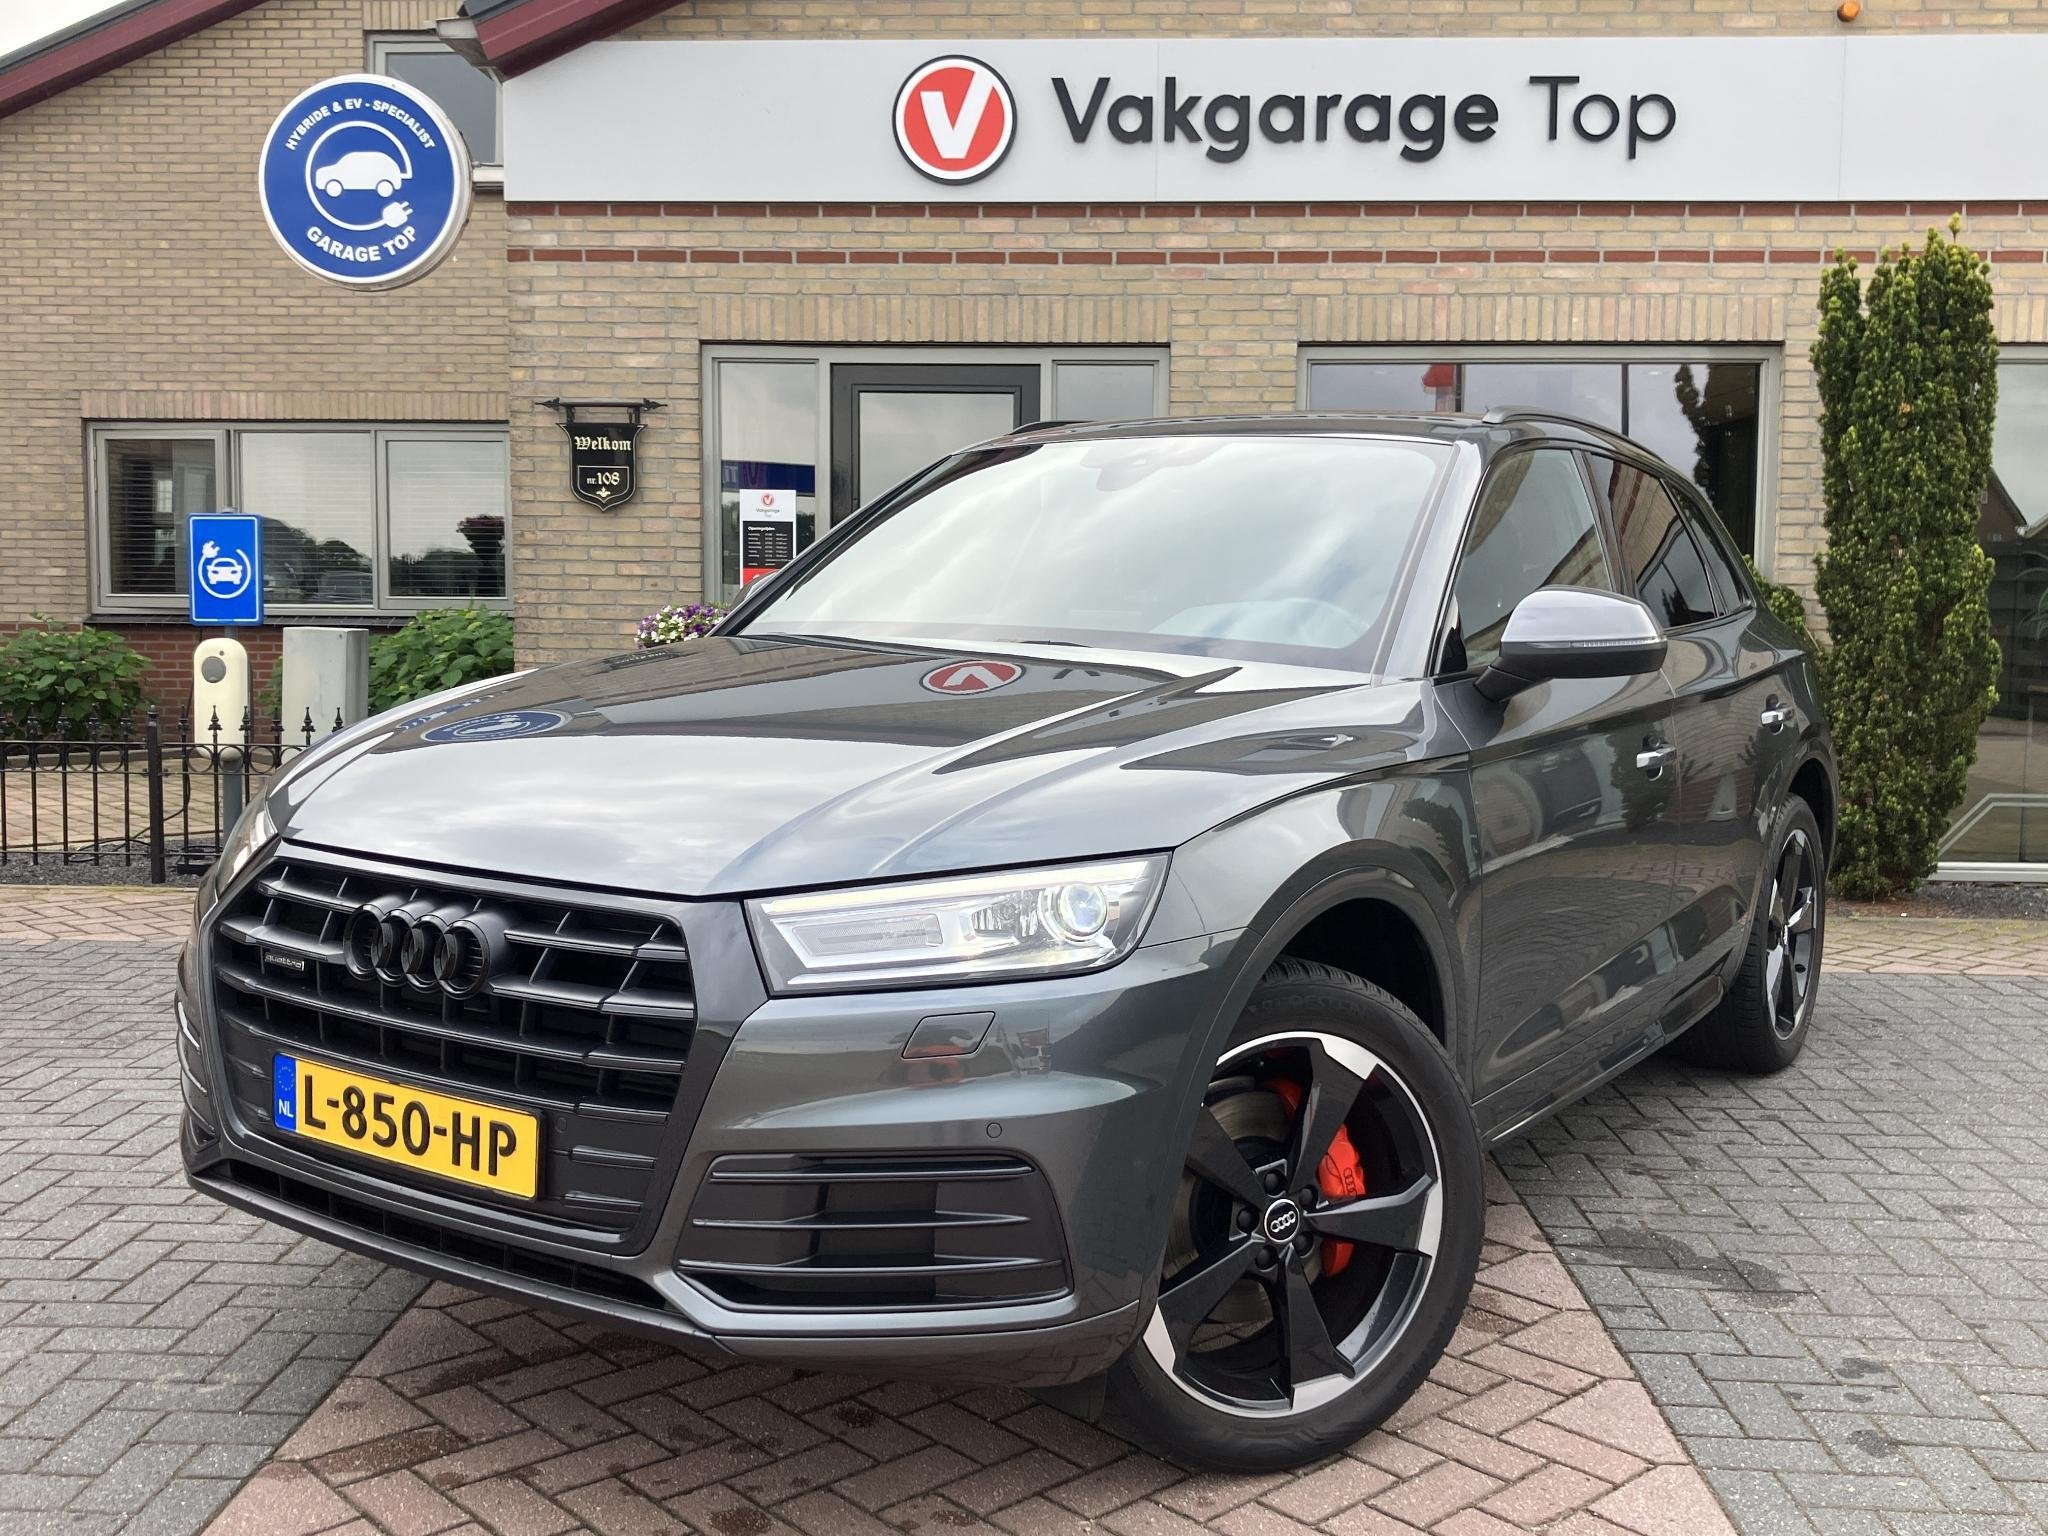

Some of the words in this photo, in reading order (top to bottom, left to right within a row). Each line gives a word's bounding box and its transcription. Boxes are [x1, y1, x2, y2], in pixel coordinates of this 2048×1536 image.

[285, 105, 331, 151] HYBRIDE
[332, 101, 343, 113] &
[345, 98, 363, 110] EV
[372, 100, 436, 150] SPECIALIST
[1051, 76, 1499, 162] Vakgarage
[1528, 75, 1677, 160] Top
[306, 226, 382, 263] GARAGE
[382, 226, 417, 256] TOP
[574, 436, 632, 451] Welkom
[278, 1098, 295, 1118] NL
[303, 1073, 518, 1177] L-850-HP
